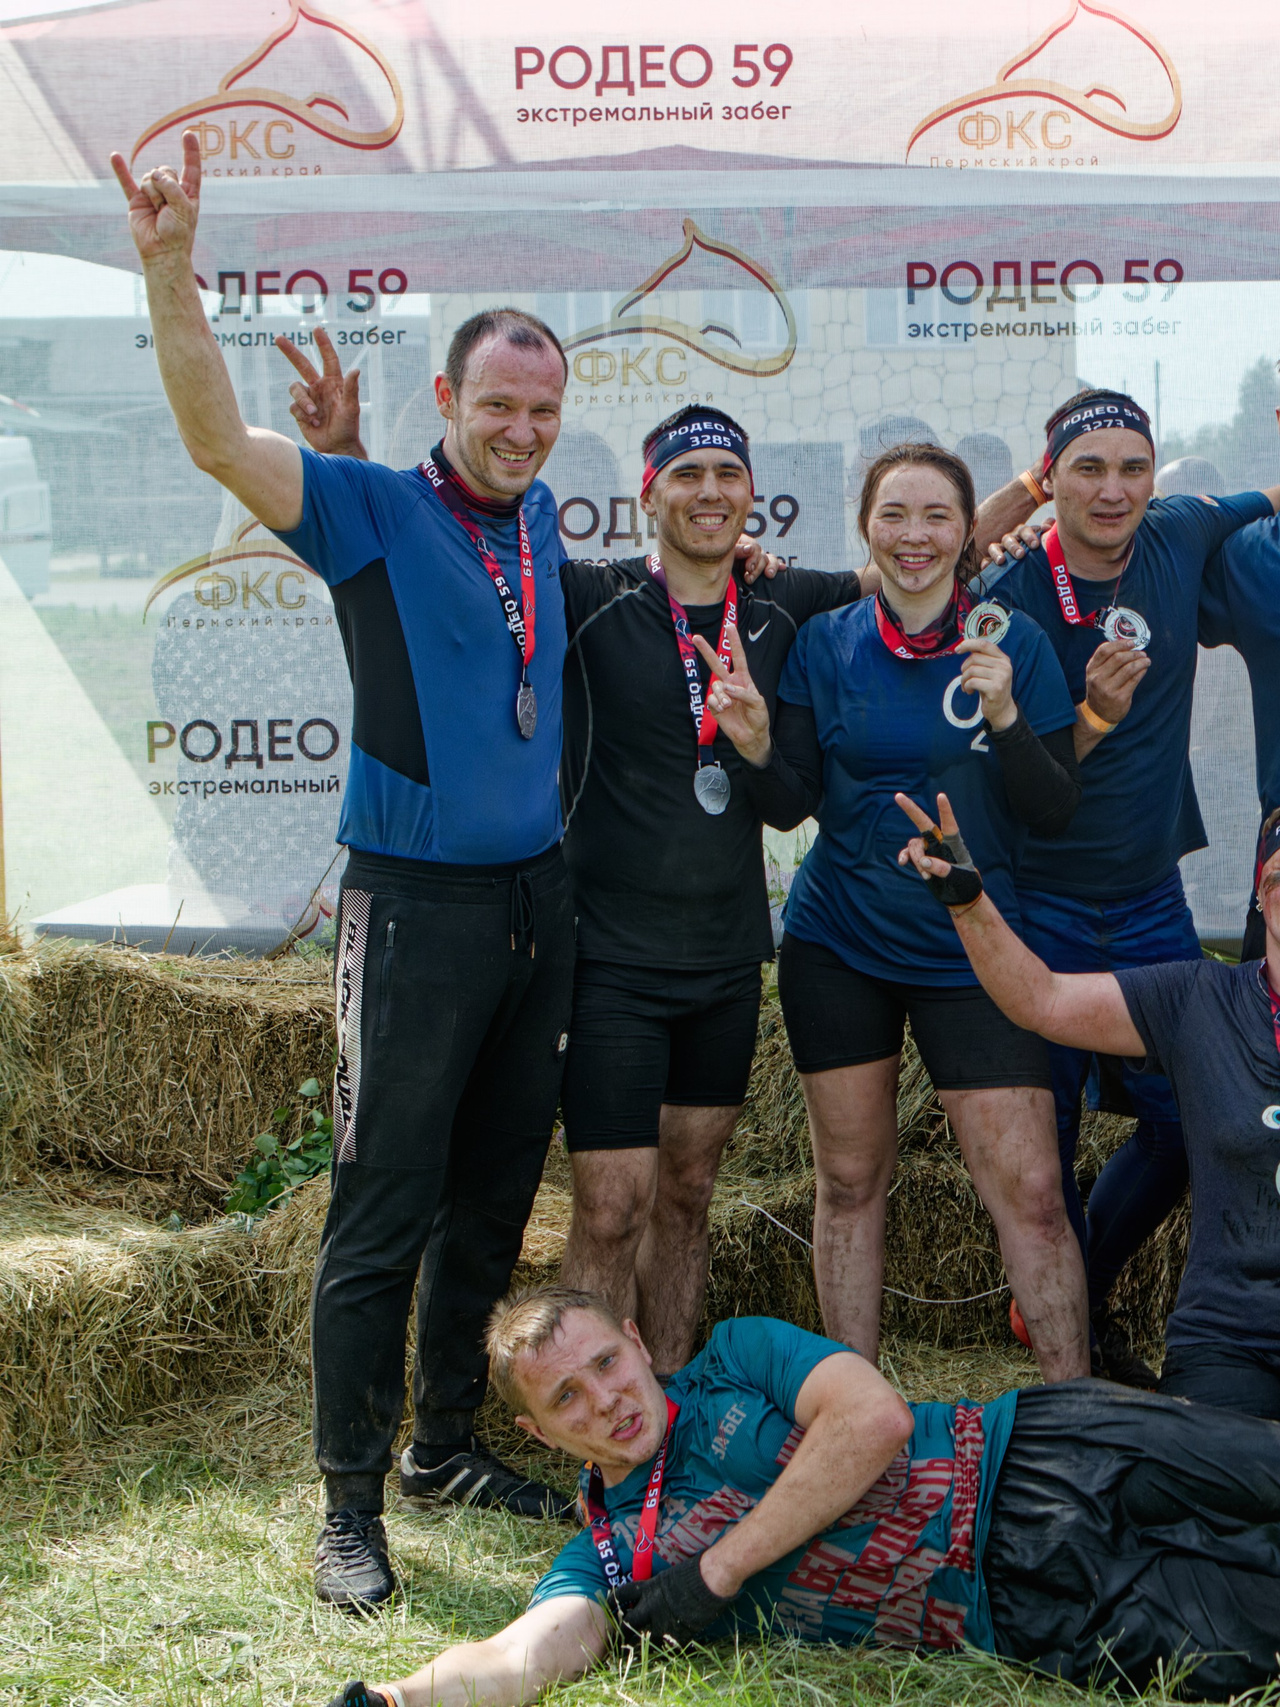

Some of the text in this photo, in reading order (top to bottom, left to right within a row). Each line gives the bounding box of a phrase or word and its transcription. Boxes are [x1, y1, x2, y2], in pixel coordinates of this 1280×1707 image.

[515, 43, 794, 97] РОДЕО 59
[516, 101, 792, 127] экстремальный забег
[182, 120, 296, 160] ФКС
[957, 110, 1072, 151] ФКС
[271, 165, 323, 178] край
[930, 156, 1099, 170] Пермский край
[345, 267, 409, 314] 59
[906, 258, 1184, 312] РОДЕО 59
[337, 325, 407, 345] забег
[907, 316, 1182, 342] экстремальный забег
[573, 347, 688, 386] ФКС
[562, 391, 715, 406] ермский край
[1063, 405, 1119, 431] РОДЕО
[668, 421, 725, 441] РОДЕО
[689, 434, 732, 448] 3285
[522, 557, 532, 578] 59
[194, 571, 307, 611] ФКС
[495, 576, 511, 597] 59
[1053, 563, 1077, 617] РОДЕО
[167, 615, 335, 631] Пермский край
[684, 658, 698, 678] 59
[146, 717, 340, 770] РОДЕО
[148, 775, 341, 800] экстремальный
[646, 1486, 659, 1509] 59
[597, 1539, 614, 1560] 59
